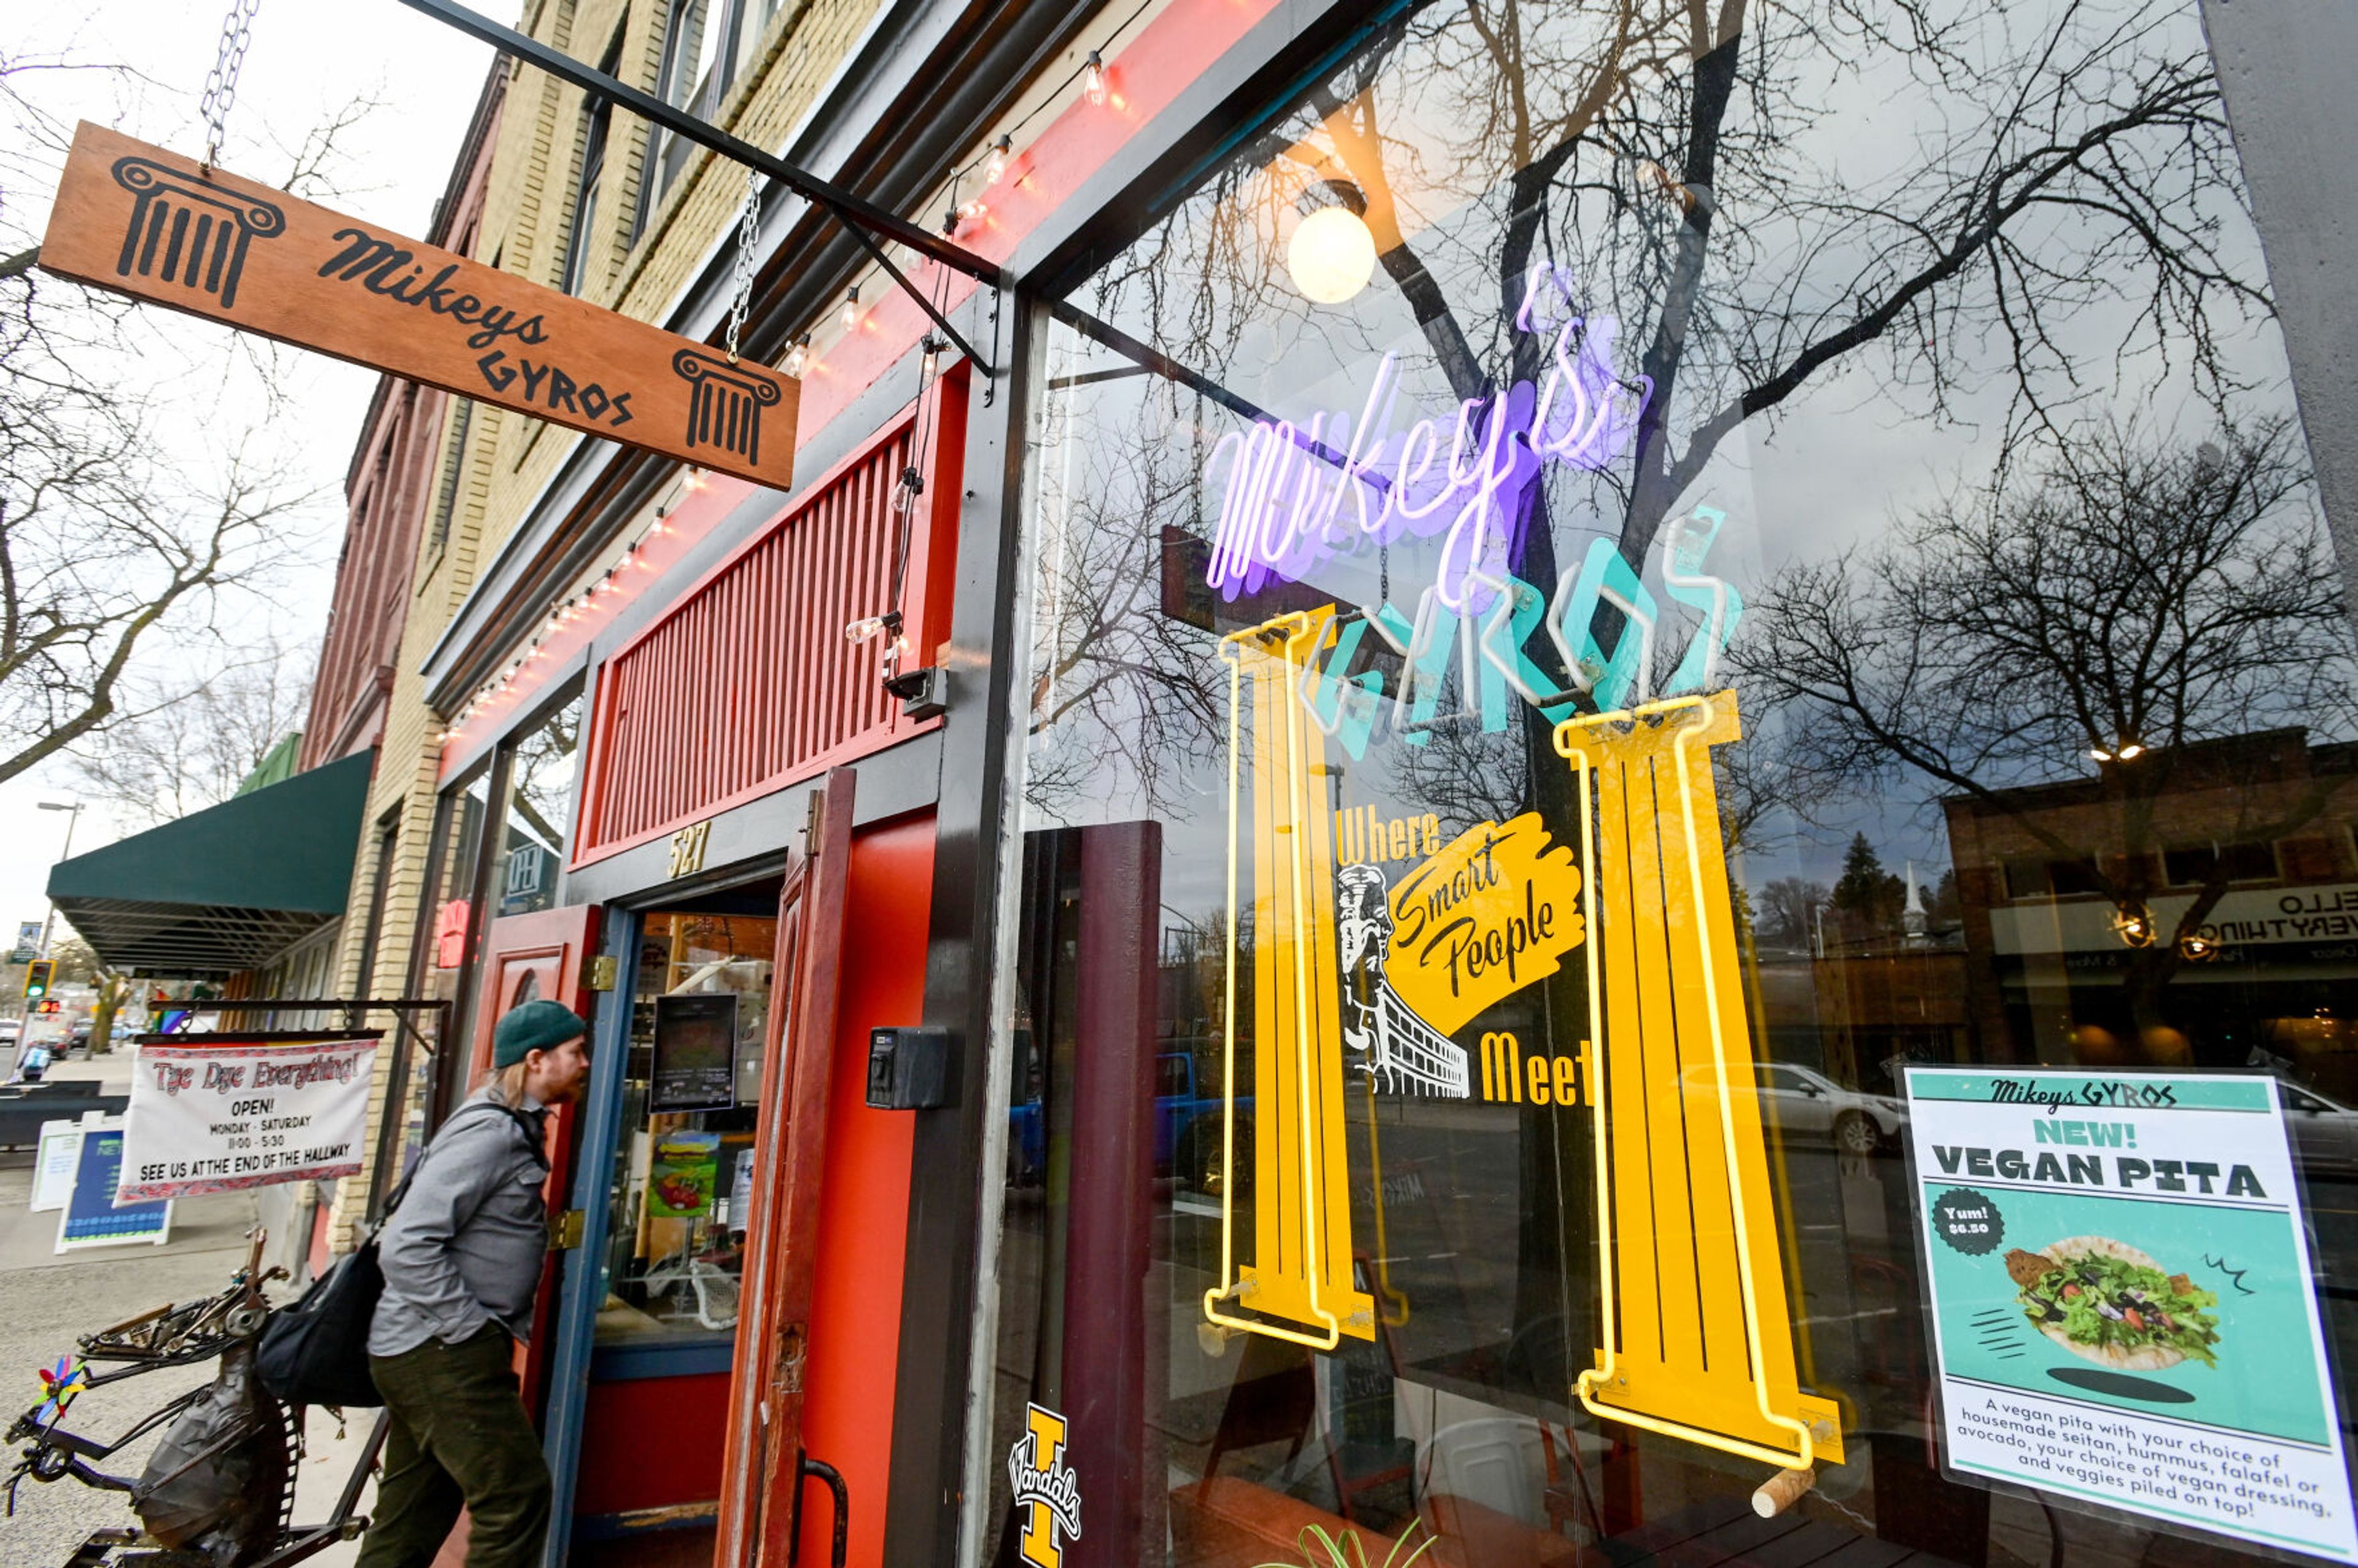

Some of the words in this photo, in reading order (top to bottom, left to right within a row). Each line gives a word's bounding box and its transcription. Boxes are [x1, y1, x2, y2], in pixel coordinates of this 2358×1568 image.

[317, 228, 548, 350] Mikeys
[477, 351, 633, 427] GYROS
[667, 820, 712, 879] 527
[1335, 804, 1441, 866] Where
[1395, 832, 1517, 949] Smart
[1419, 880, 1555, 998] People
[154, 1062, 193, 1096] Tye
[202, 1062, 246, 1095] Dye
[251, 1052, 361, 1090] Everything!
[1990, 1079, 2077, 1114] Mikeys
[2081, 1082, 2177, 1109] GYROS
[209, 1123, 250, 1136] MONDAY
[260, 1116, 311, 1131] SATURDAY
[232, 1098, 274, 1117] OPEN!
[2033, 1119, 2138, 1149] NEW!
[140, 1165, 164, 1182] SEE
[171, 1162, 186, 1178] US
[191, 1160, 206, 1176] AT
[206, 1158, 229, 1175] THE
[235, 1156, 260, 1173] END
[263, 1154, 276, 1170] OF
[279, 1150, 300, 1167] THE
[304, 1143, 351, 1164] HALLWAY
[261, 1135, 284, 1147] 5:30
[1932, 1145, 2104, 1186] VEGAN
[2117, 1157, 2268, 1199] PITA
[1944, 1206, 1989, 1221] Yum!
[1948, 1222, 1989, 1235] $6.50
[1958, 1424, 2032, 1452] avocado,
[2037, 1443, 2074, 1459] your
[2080, 1451, 2136, 1473] choice
[2143, 1465, 2160, 1477] of
[2167, 1471, 2228, 1494] vegan
[1962, 1408, 2056, 1439] housemade
[2063, 1430, 2122, 1456] seitan,
[2128, 1443, 2214, 1475] hummus,
[2221, 1462, 2290, 1488] falafel
[2298, 1481, 2319, 1493] or
[1986, 1399, 1998, 1411] A
[2002, 1403, 2053, 1422] vegan
[2059, 1413, 2093, 1432] pita
[2099, 1422, 2136, 1440] with
[2142, 1432, 2184, 1450] your
[2190, 1440, 2254, 1464] choice
[2260, 1453, 2281, 1469] of
[1009, 1434, 1081, 1529] Vandals
[2018, 1454, 2050, 1470] and
[2056, 1463, 2124, 1488] veggies
[2130, 1480, 2177, 1500] piled
[2184, 1492, 2208, 1507] on
[2214, 1497, 2255, 1518] top!
